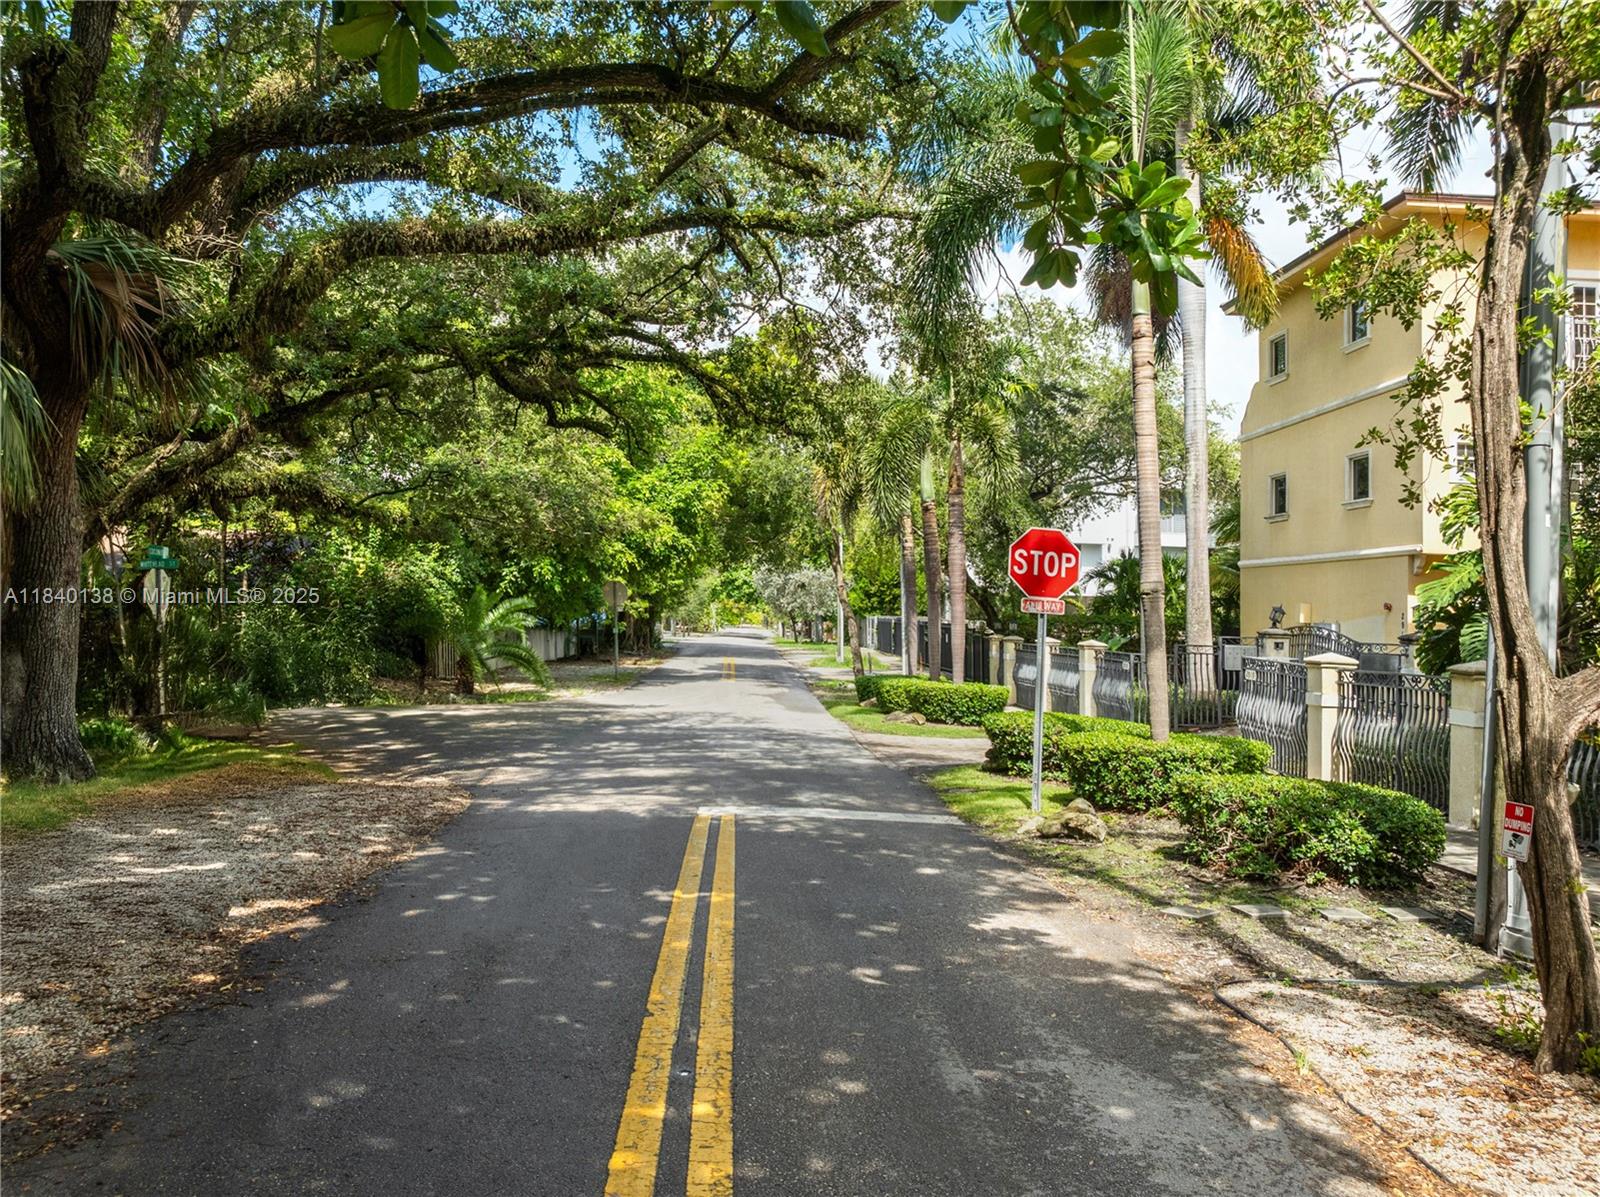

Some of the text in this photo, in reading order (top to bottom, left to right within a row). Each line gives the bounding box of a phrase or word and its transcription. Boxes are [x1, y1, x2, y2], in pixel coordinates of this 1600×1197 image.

[1013, 548, 1076, 578] STOP
[1044, 601, 1062, 613] WAY
[1515, 806, 1524, 816] NO
[1504, 818, 1531, 832] DUMPING
